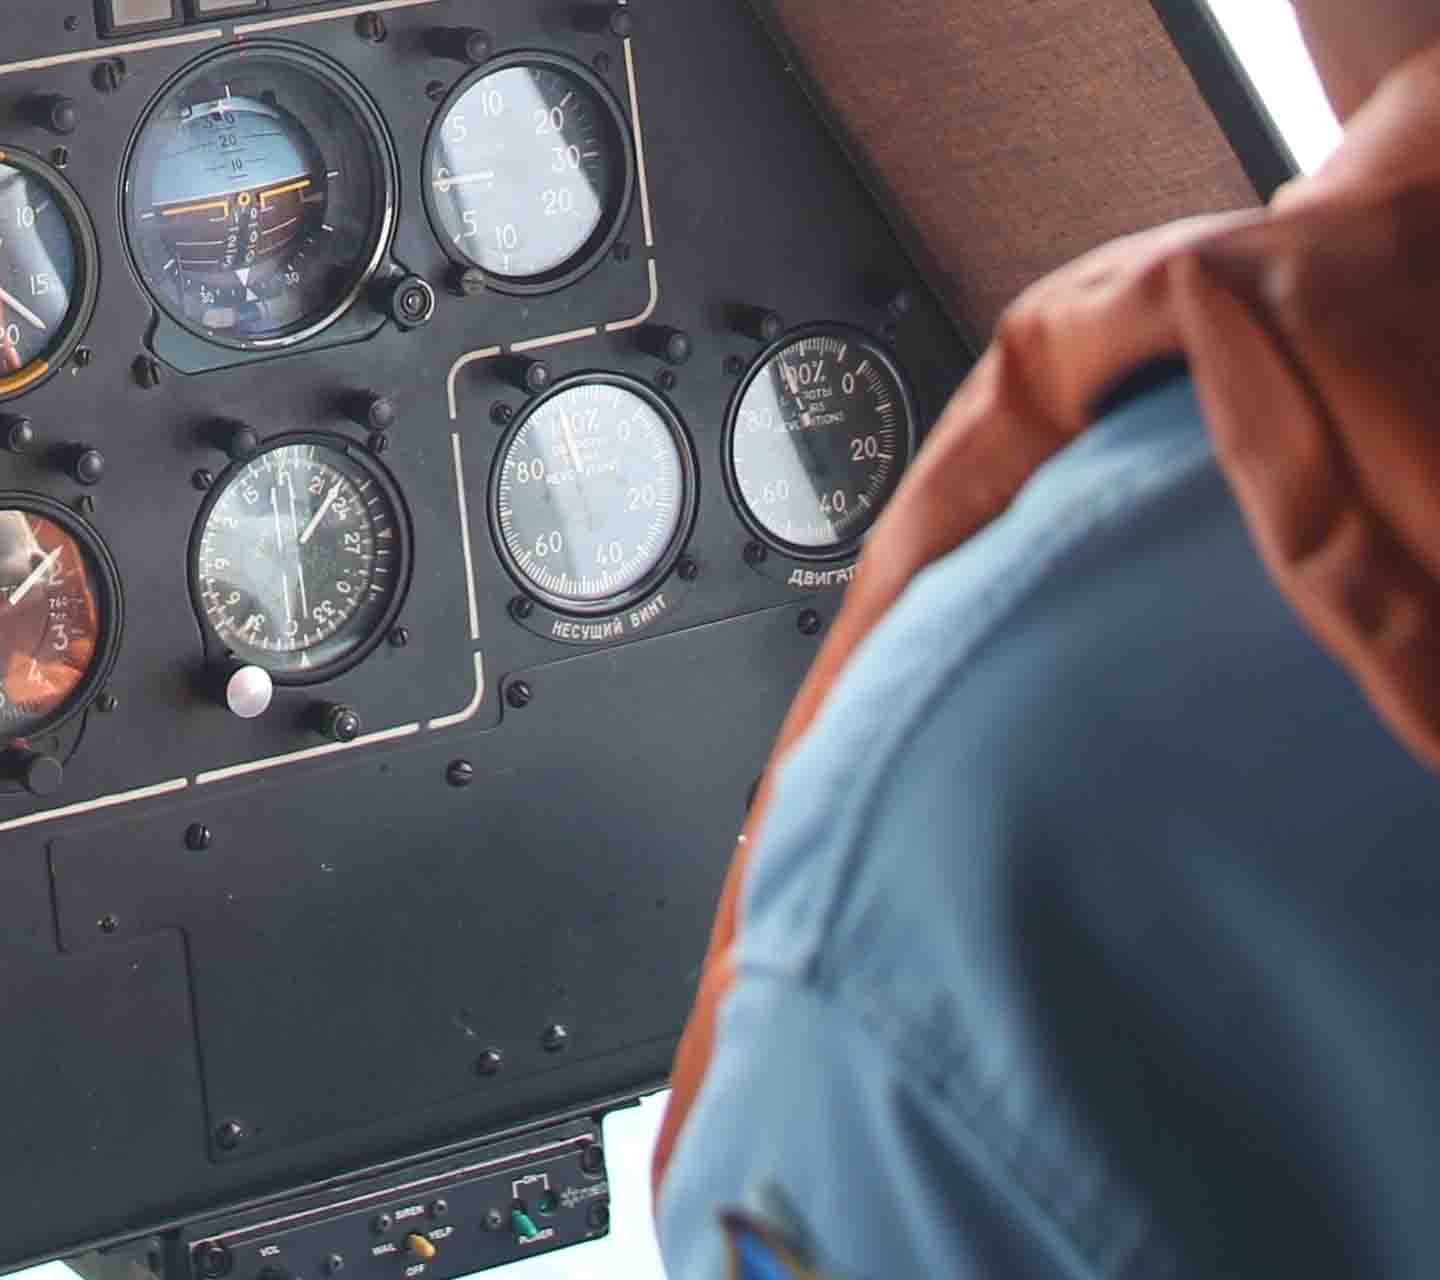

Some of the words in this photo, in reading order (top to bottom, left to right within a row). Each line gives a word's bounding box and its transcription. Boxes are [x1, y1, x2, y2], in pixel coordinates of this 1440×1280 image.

[481, 90, 503, 117] 10
[448, 115, 467, 142] 5
[534, 106, 564, 135] 20
[551, 144, 580, 172] 30
[542, 189, 571, 216] 20
[16, 205, 34, 228] 10
[463, 210, 477, 238] 5
[495, 223, 518, 250] 10
[30, 272, 50, 296] 15
[842, 372, 856, 394] 0
[850, 435, 878, 462] 20
[517, 458, 545, 484] 80
[627, 484, 656, 512] 20
[535, 530, 563, 558] 60
[551, 616, 624, 640] НЕСУЩИЙ
[630, 593, 667, 628] ВИНТ
[51, 623, 69, 651] 3
[28, 658, 42, 683] 4
[405, 1264, 426, 1277] OFF
